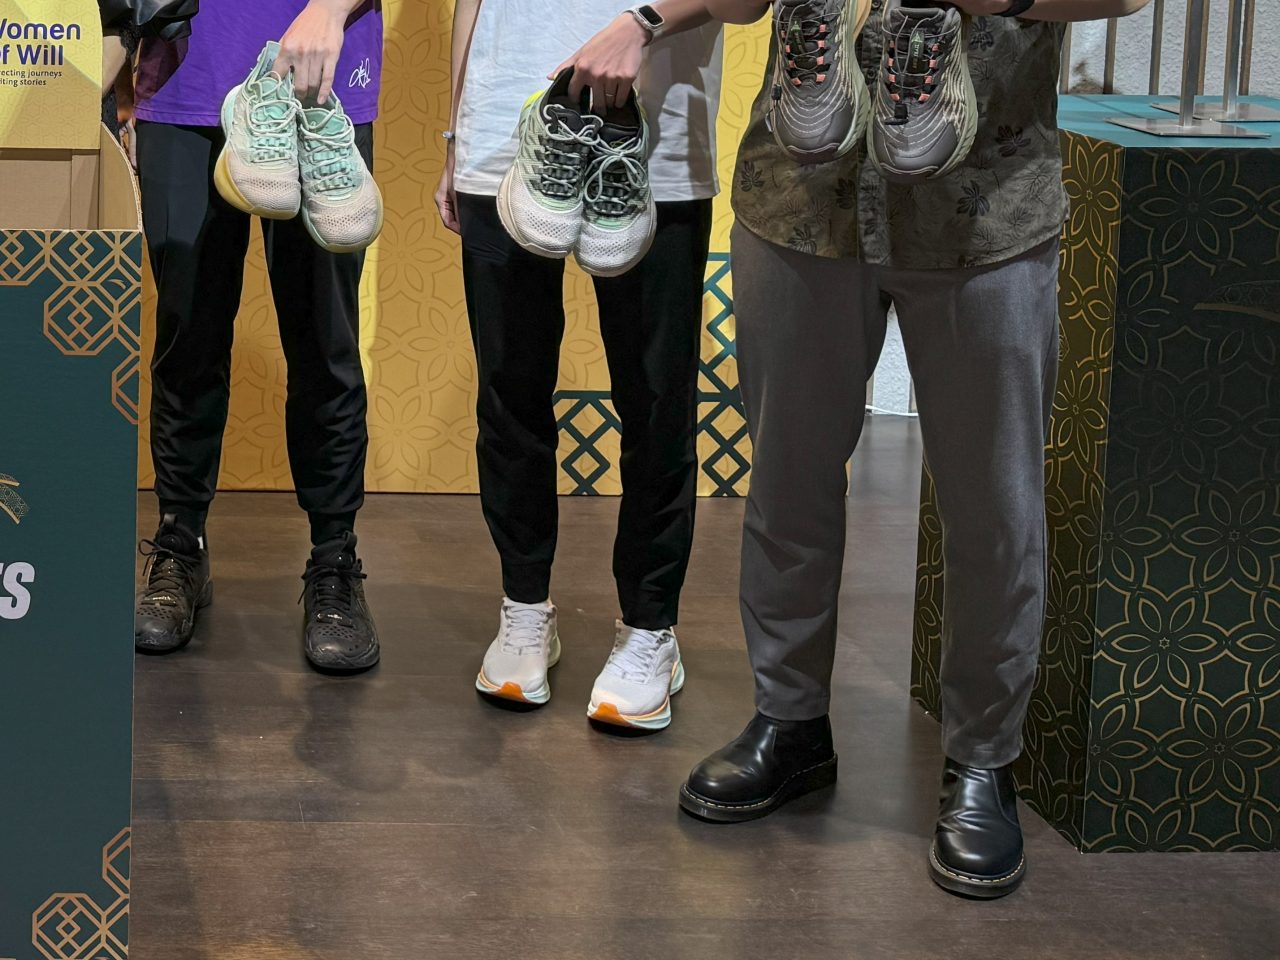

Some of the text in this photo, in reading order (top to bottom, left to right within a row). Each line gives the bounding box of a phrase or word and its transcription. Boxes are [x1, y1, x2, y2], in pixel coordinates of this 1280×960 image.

[16, 44, 64, 66] Will
[27, 69, 63, 80] journeys
[19, 77, 47, 87] stories
